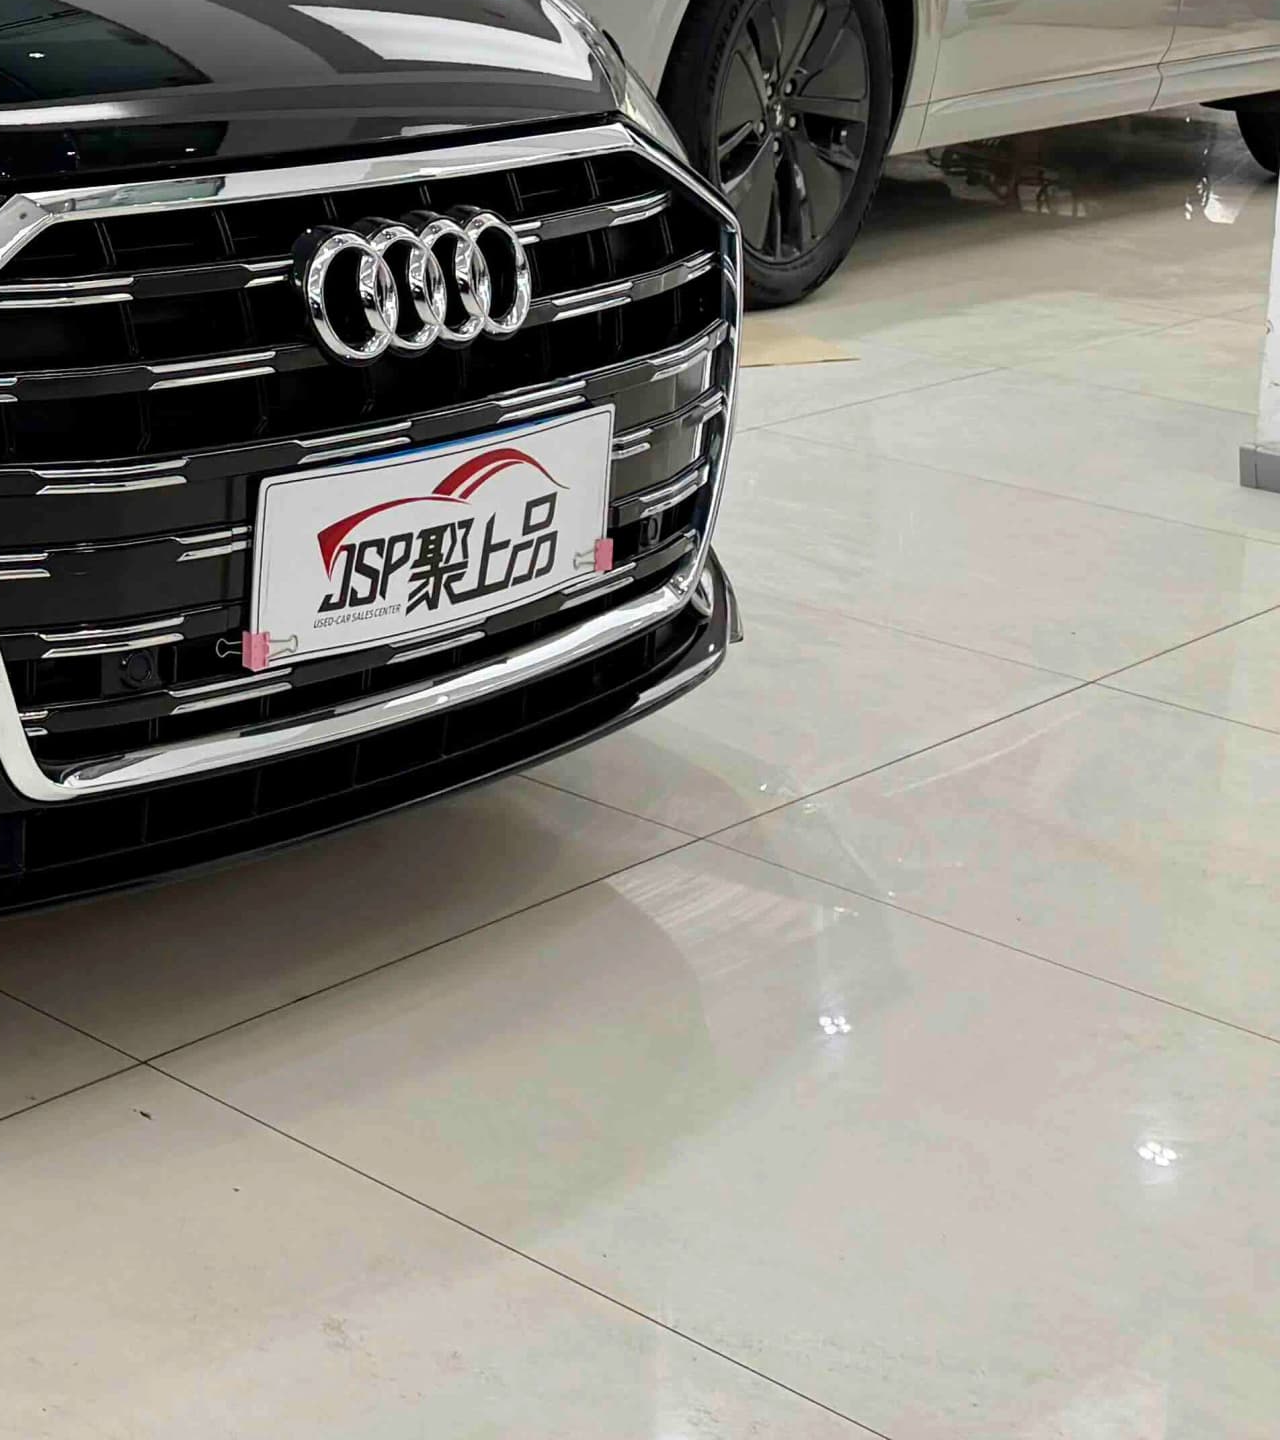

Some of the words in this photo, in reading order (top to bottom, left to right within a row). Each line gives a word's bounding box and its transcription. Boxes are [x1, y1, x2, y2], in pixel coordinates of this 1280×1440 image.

[317, 531, 414, 613] JSP
[405, 491, 558, 617] 聚上品
[313, 614, 350, 629] USED-CAR
[352, 609, 373, 622] SALES
[374, 603, 401, 616] CENTER
